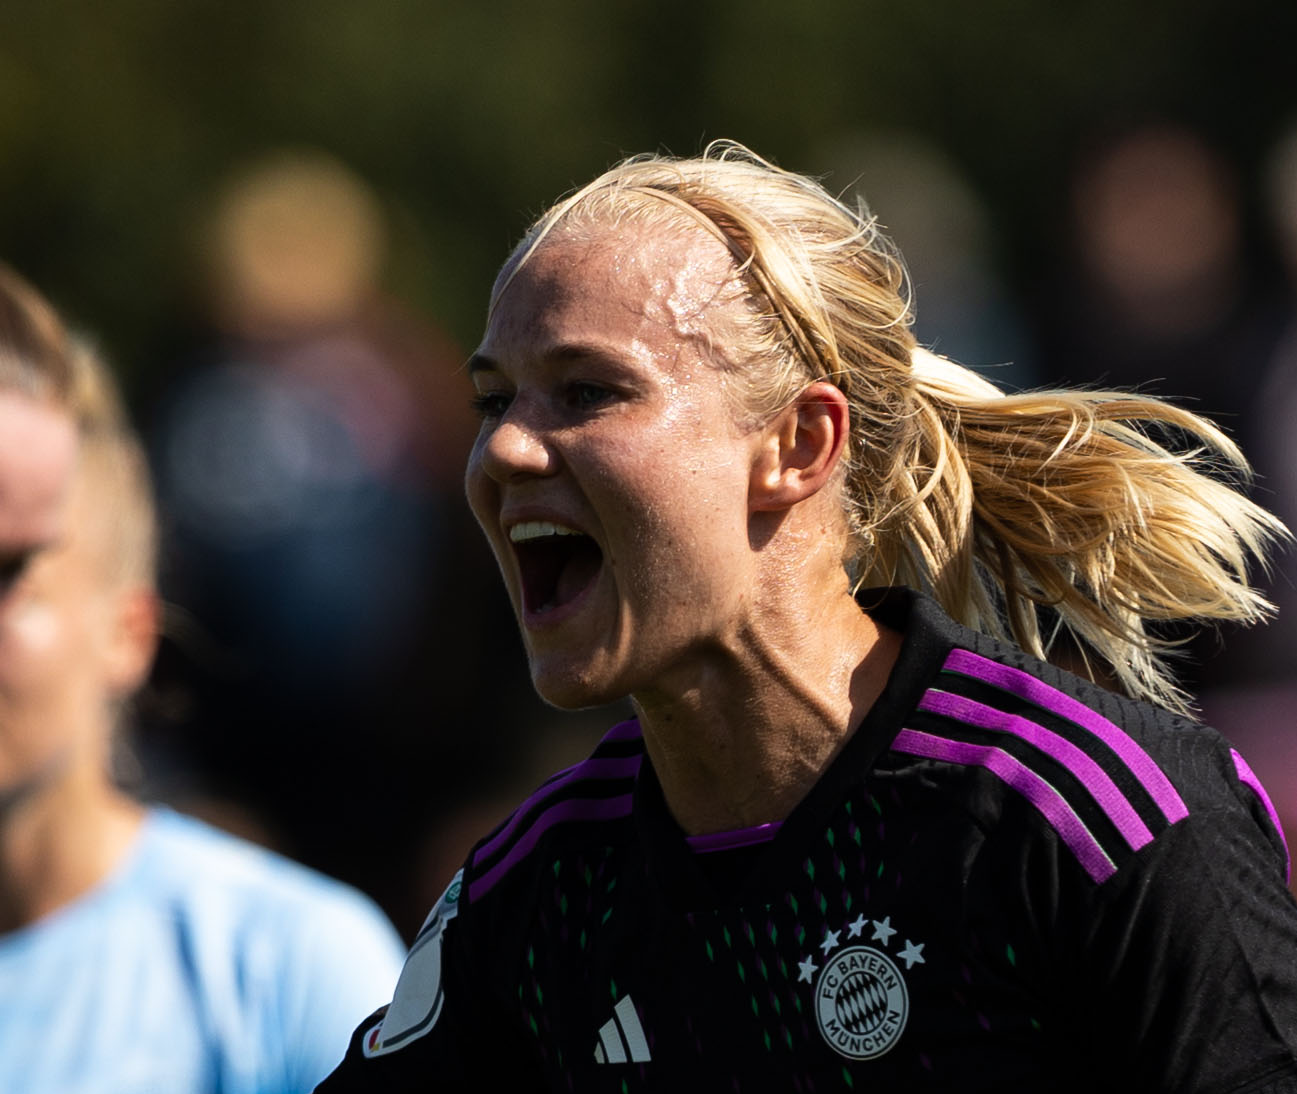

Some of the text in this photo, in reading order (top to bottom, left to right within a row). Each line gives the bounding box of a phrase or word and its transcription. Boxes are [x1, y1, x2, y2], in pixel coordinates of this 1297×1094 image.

[822, 954, 898, 1001] FC BAYERN
[824, 1009, 901, 1053] MÜNCHEN
